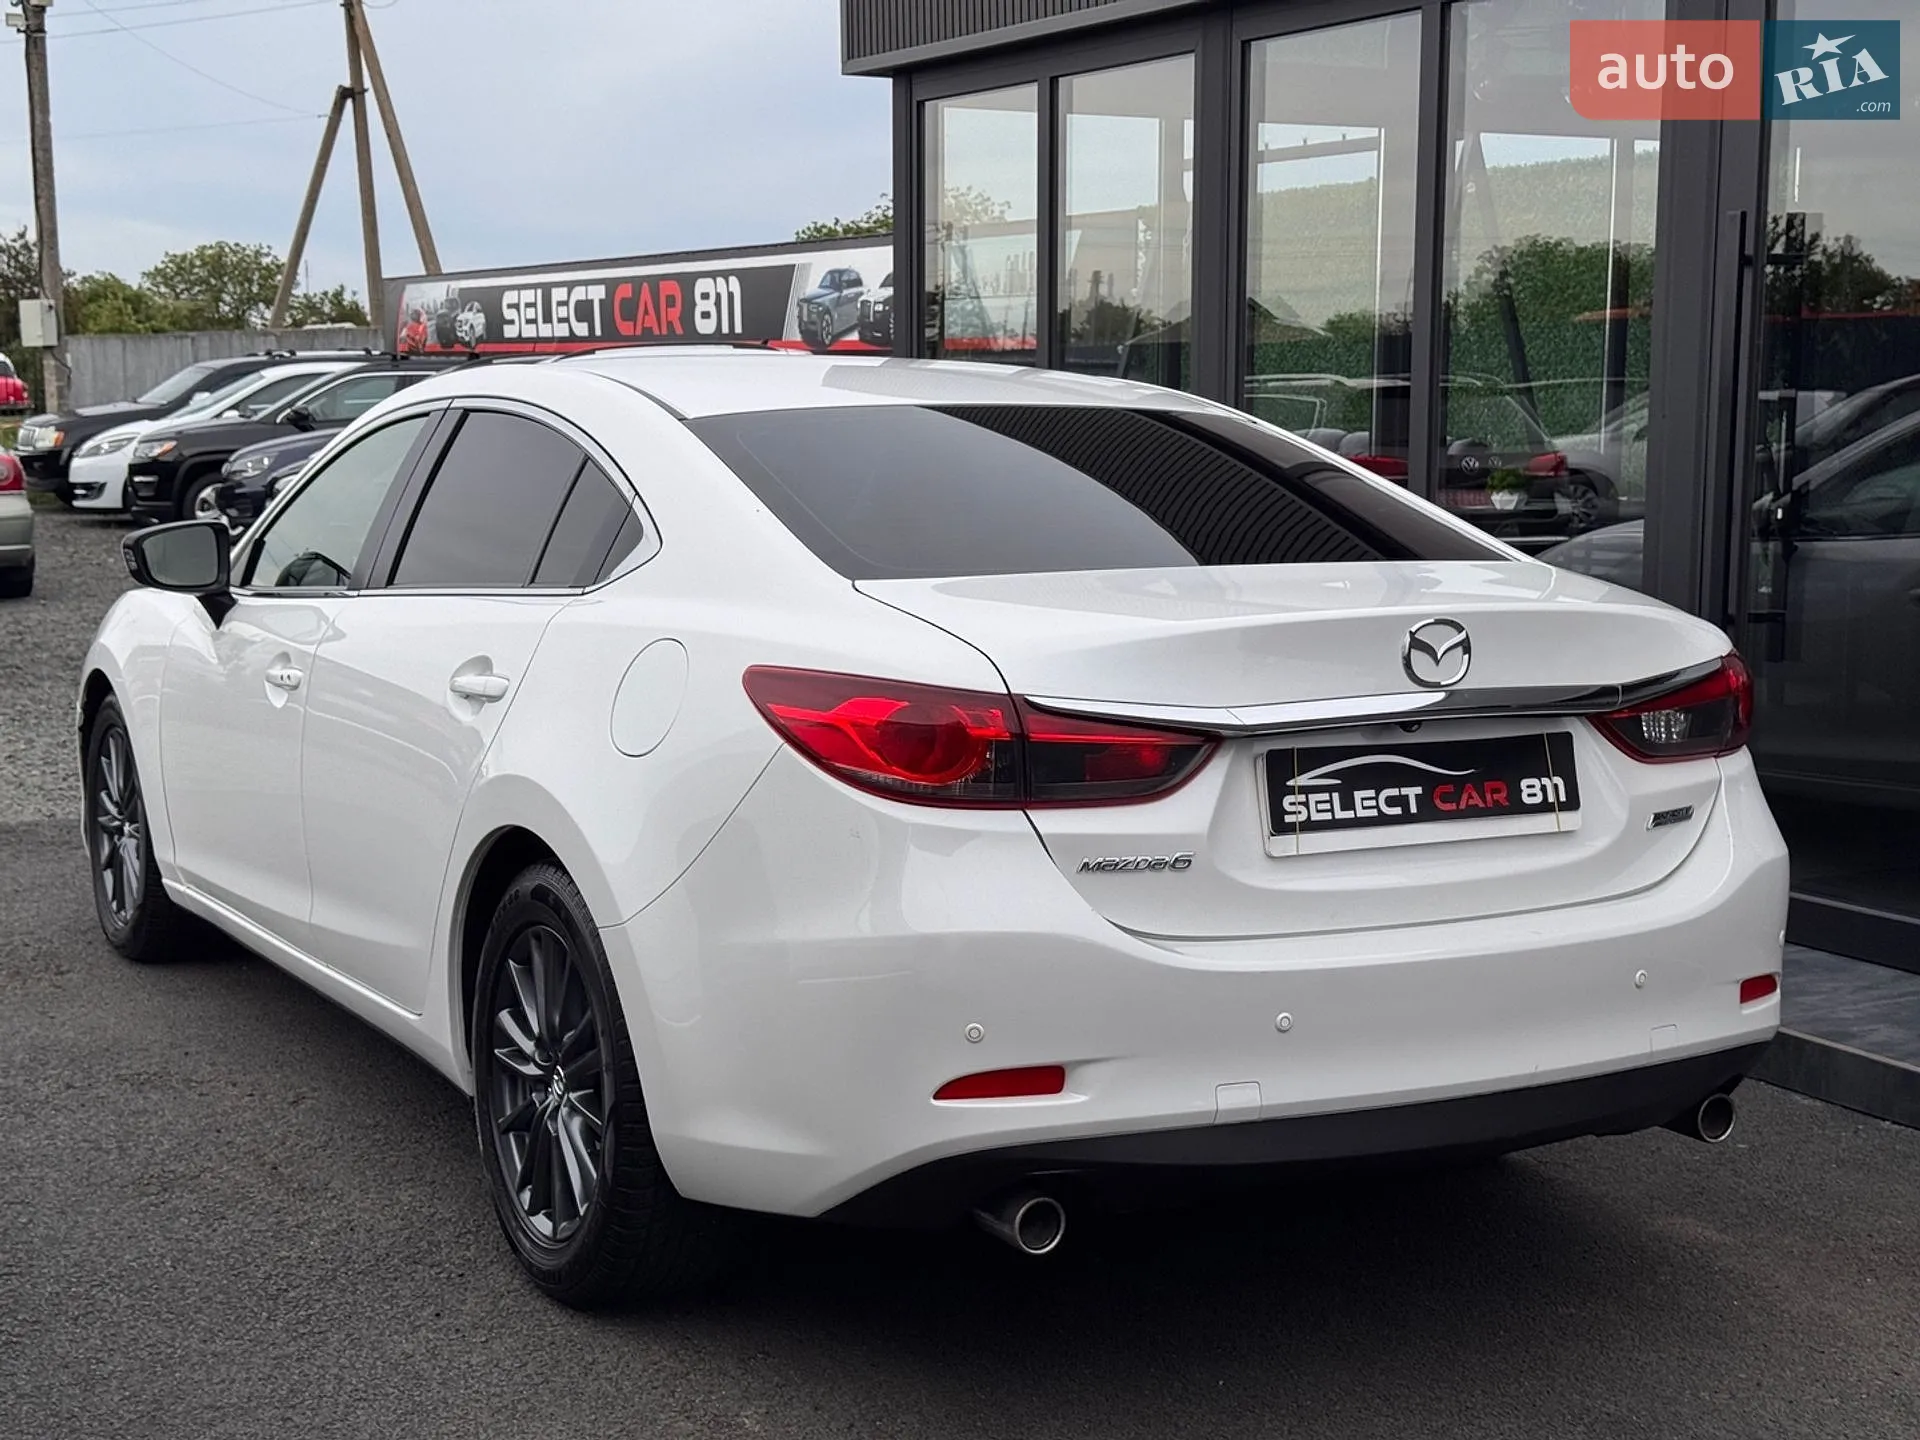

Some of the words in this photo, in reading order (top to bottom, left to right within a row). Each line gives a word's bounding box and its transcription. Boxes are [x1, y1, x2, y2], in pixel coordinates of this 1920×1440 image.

[501, 284, 607, 338] SELECT
[613, 279, 684, 336] CAR
[694, 275, 743, 335] 811
[1282, 786, 1423, 823] SELECT
[1432, 780, 1511, 812] CAR
[1519, 775, 1567, 805] 811
